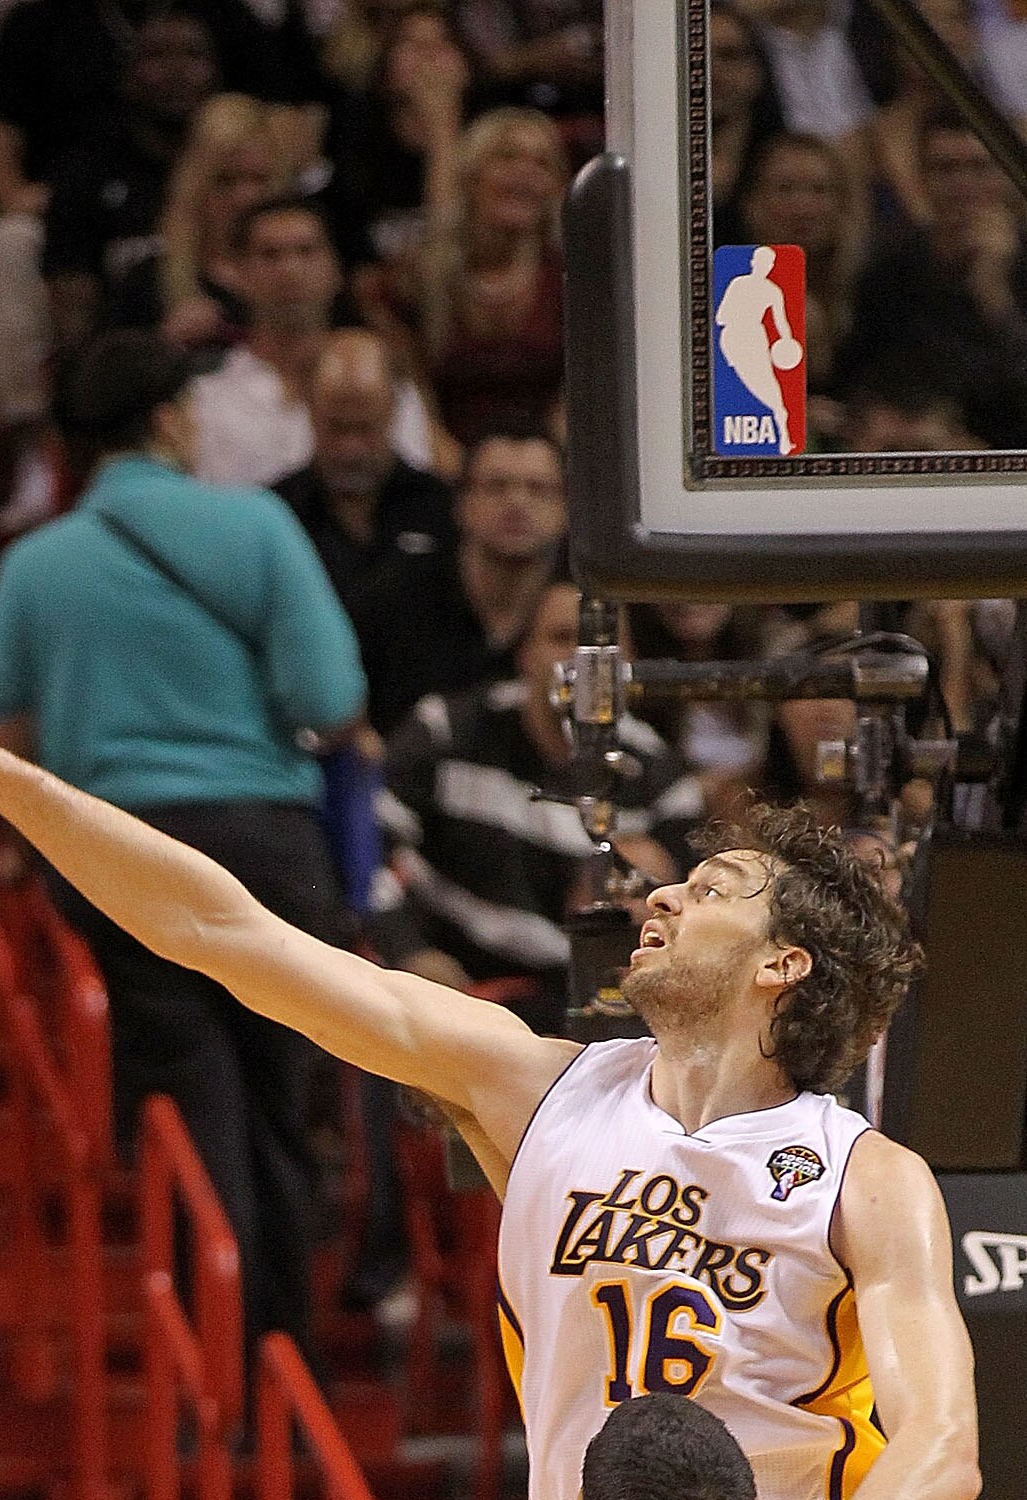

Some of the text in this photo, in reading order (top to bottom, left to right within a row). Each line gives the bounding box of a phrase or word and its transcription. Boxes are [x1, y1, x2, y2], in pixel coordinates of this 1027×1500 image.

[723, 415, 777, 444] NBA
[600, 1168, 711, 1227] LOS
[549, 1190, 774, 1313] LAKERS
[590, 1278, 722, 1408] 16
